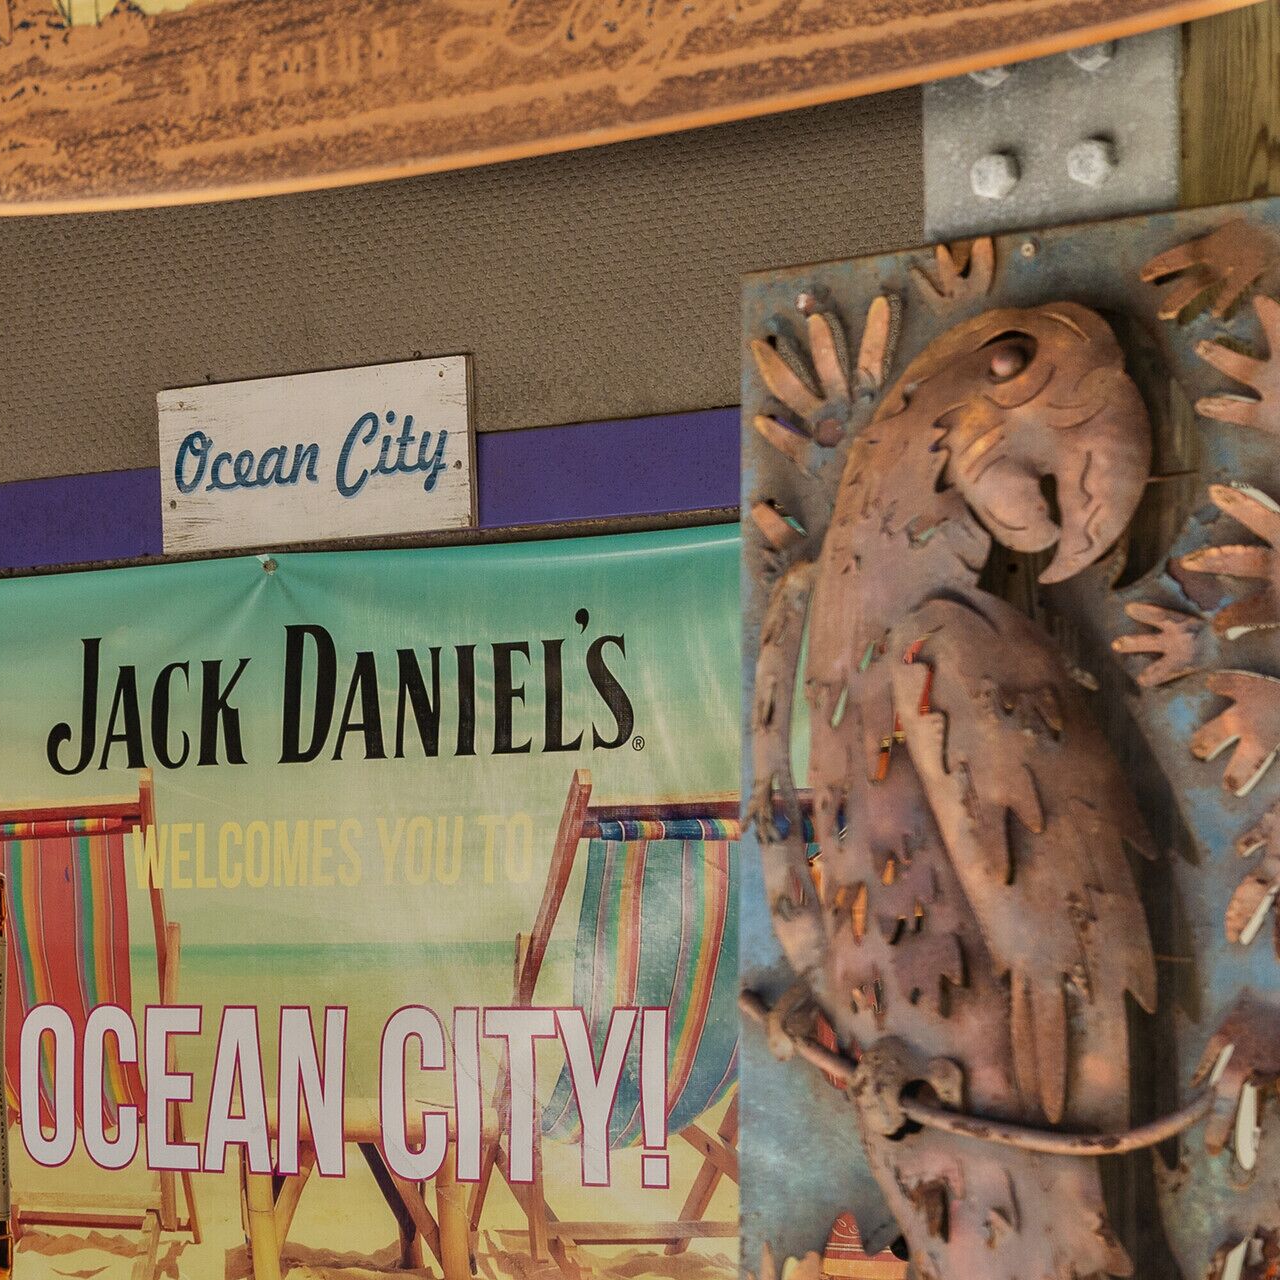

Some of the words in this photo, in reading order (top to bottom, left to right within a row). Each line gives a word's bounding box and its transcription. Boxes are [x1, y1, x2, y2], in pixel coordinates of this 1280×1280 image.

[174, 430, 319, 495] Ocean
[335, 410, 448, 499] City
[46, 637, 252, 776] JACK
[131, 818, 363, 891] WELCOMES
[377, 815, 464, 885] YOU
[477, 810, 534, 885] TO
[17, 1002, 348, 1179] OCEAN
[378, 1003, 671, 1190] CITY!
